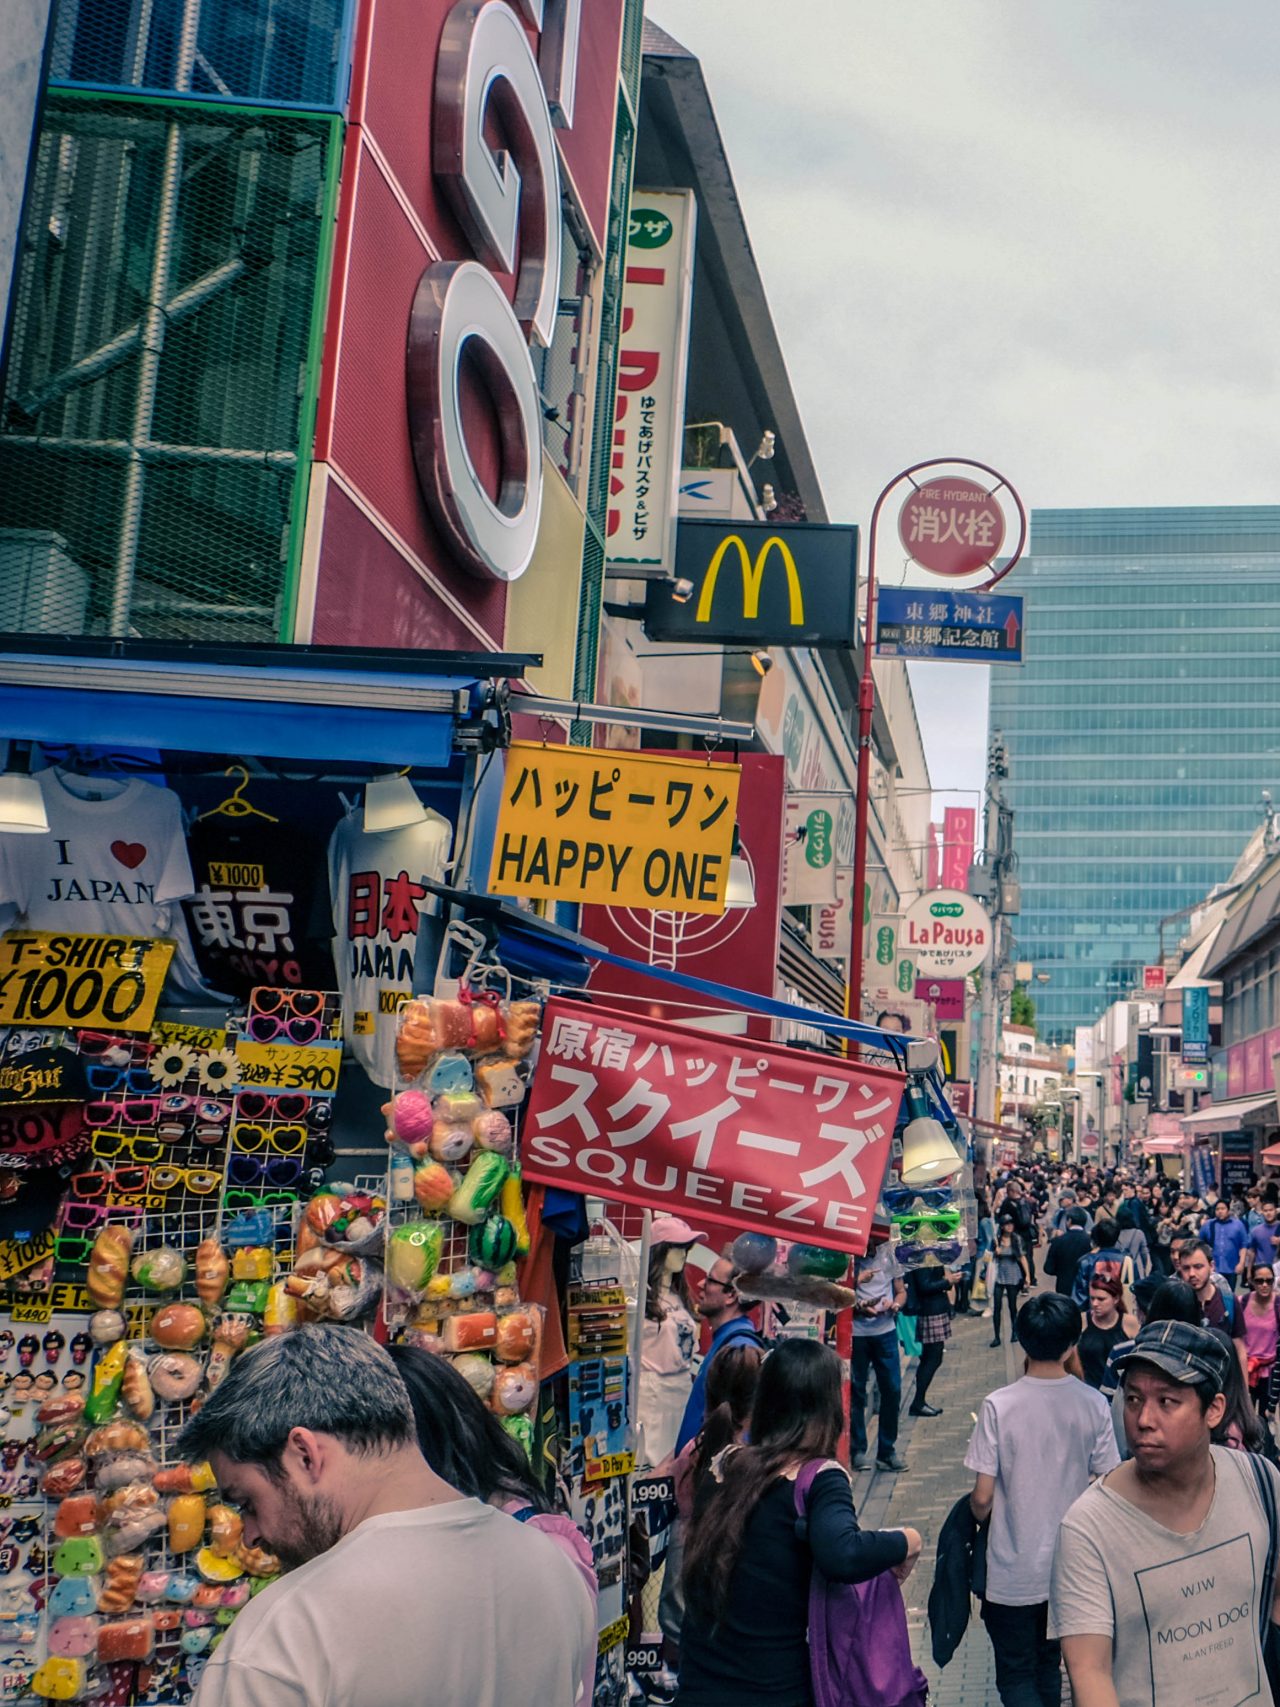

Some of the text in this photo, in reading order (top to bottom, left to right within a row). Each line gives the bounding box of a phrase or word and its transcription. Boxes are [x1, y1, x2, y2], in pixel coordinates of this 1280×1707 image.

[408, 0, 582, 580] GO
[919, 488, 988, 503] FIRE HYDRANT
[909, 505, 996, 547] 消火栓
[906, 602, 995, 624] 東郷神社
[903, 625, 1000, 649] 東郷記念館
[510, 767, 729, 831] ハッピーワン
[55, 840, 73, 865] I
[497, 833, 633, 892] HAPPY
[643, 848, 722, 901] ONE
[951, 817, 968, 891] DAISO
[210, 864, 260, 886] ¥1000
[46, 879, 155, 905] JAPAN
[348, 870, 427, 942] 日本
[190, 884, 294, 953] 東京
[909, 921, 985, 947] La Pausa
[7, 937, 153, 968] T-SHIRT
[352, 944, 414, 982] JAPAN
[160, 1030, 213, 1049] ¥540
[265, 1047, 330, 1063] サングラス
[546, 1016, 892, 1120] 原宿ハッピーワン
[535, 1065, 885, 1199] スクイーズ
[528, 1136, 868, 1235] SQUEEZE
[110, 1196, 163, 1208] ¥540
[1, 1228, 55, 1272] ¥1080
[16, 1309, 48, 1321] ¥490
[1181, 1576, 1215, 1598] WJW
[1157, 1602, 1249, 1645] MOON DOG
[1208, 1637, 1234, 1654] FREED
